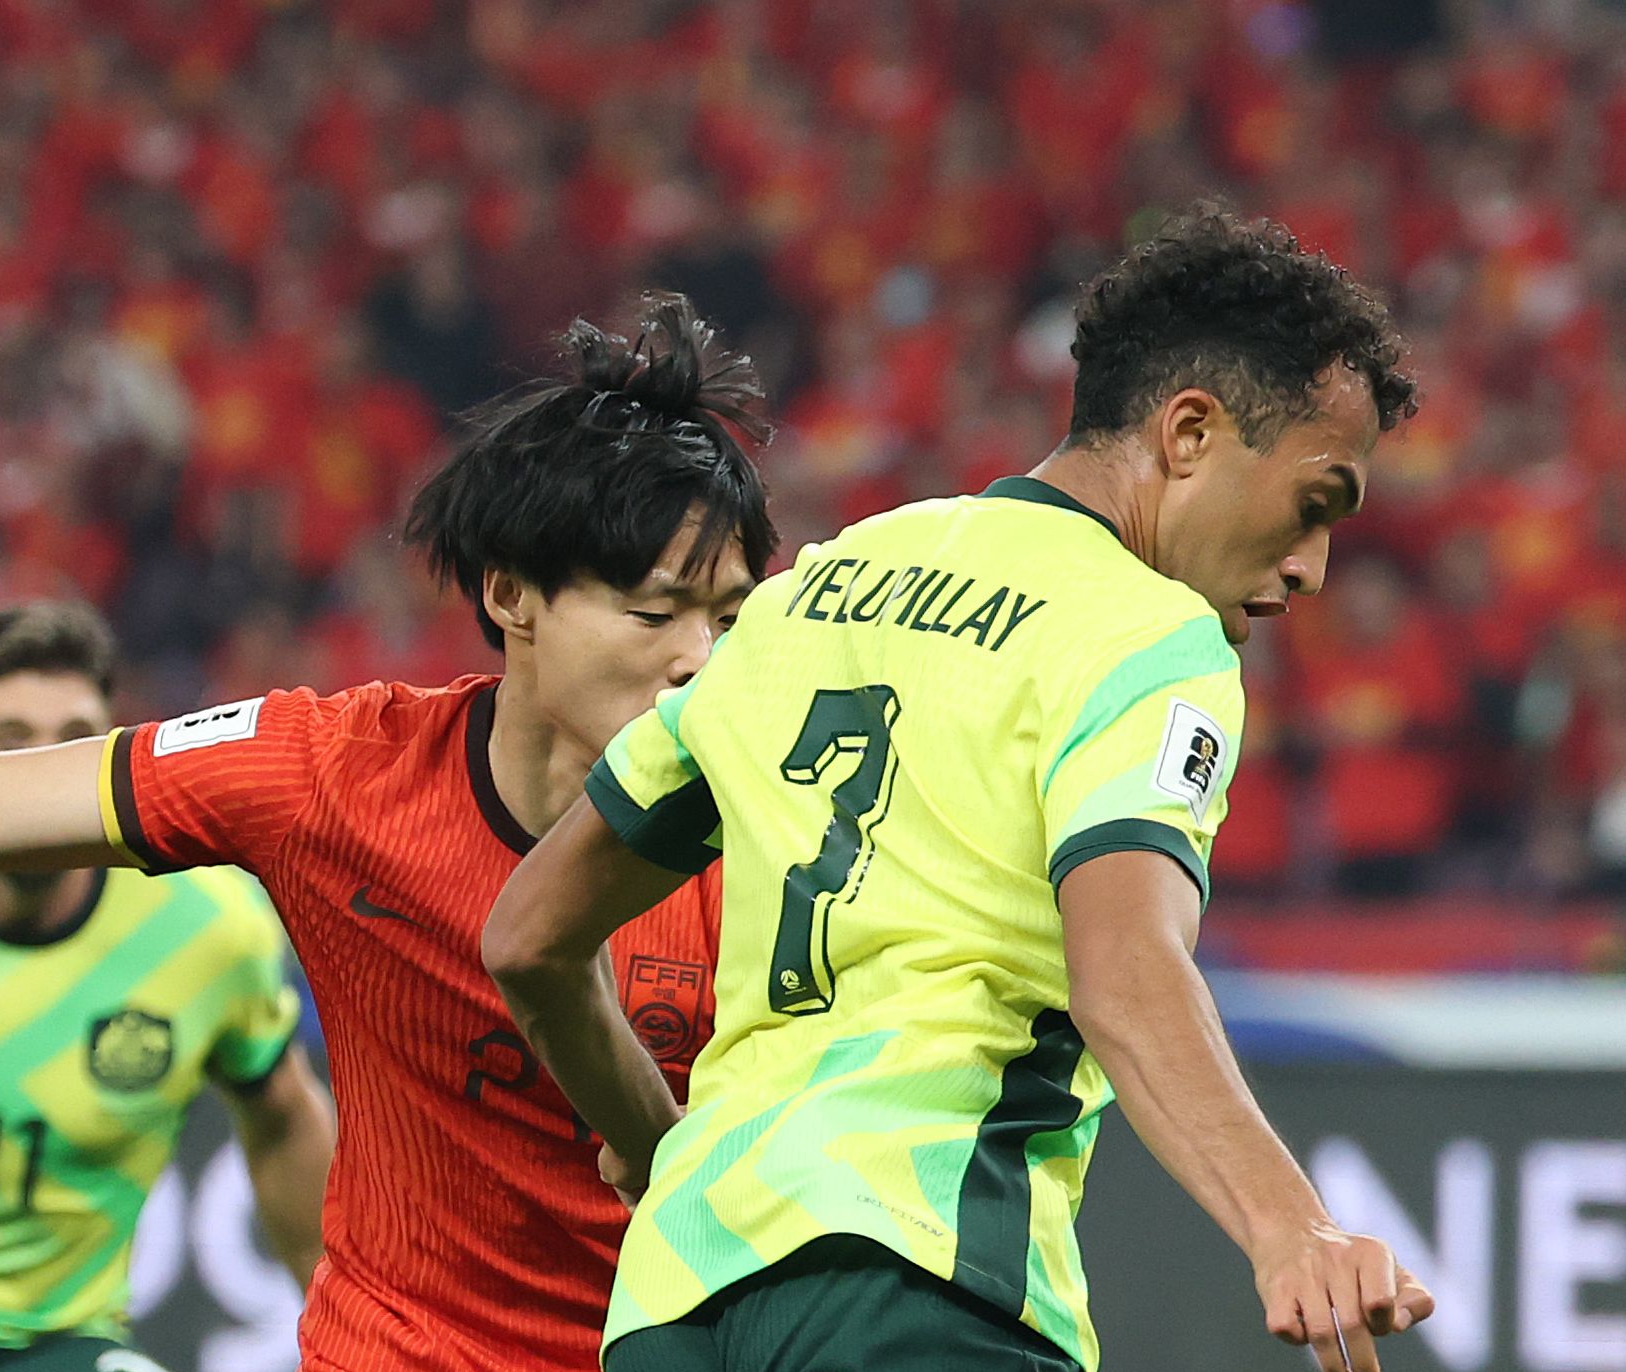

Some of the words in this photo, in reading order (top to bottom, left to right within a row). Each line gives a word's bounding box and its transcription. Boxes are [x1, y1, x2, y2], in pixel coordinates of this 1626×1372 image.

[785, 558, 1048, 652] VELUPILLAY
[768, 685, 902, 1017] 7
[635, 963, 698, 990] CFA
